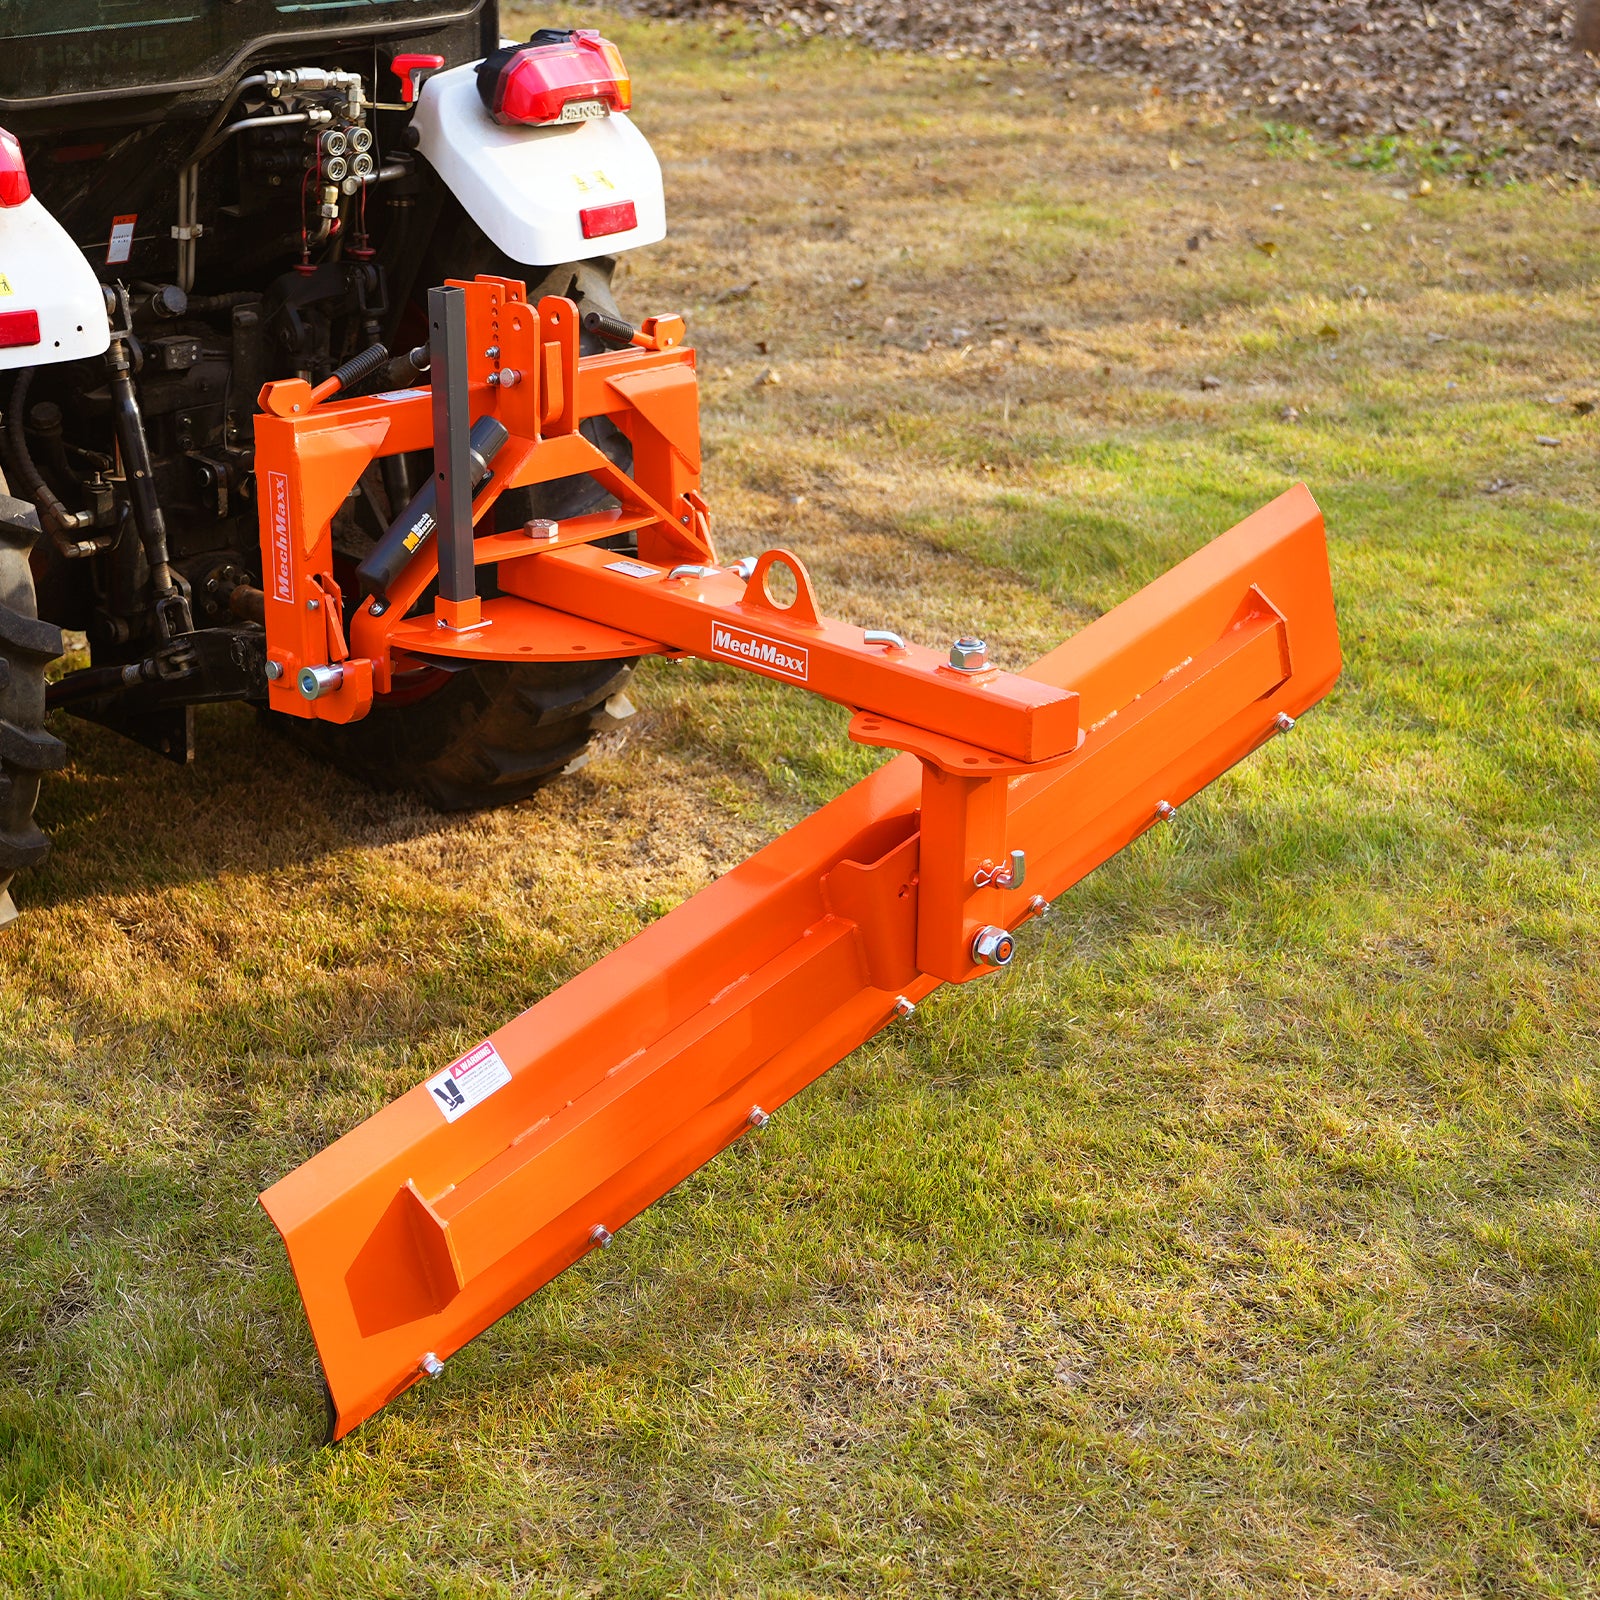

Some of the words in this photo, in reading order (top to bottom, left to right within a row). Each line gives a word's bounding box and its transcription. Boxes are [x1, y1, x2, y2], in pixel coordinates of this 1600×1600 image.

[276, 478, 290, 598] MechMaxx
[715, 629, 804, 672] MechMaxx
[460, 1046, 492, 1070] WARNING
